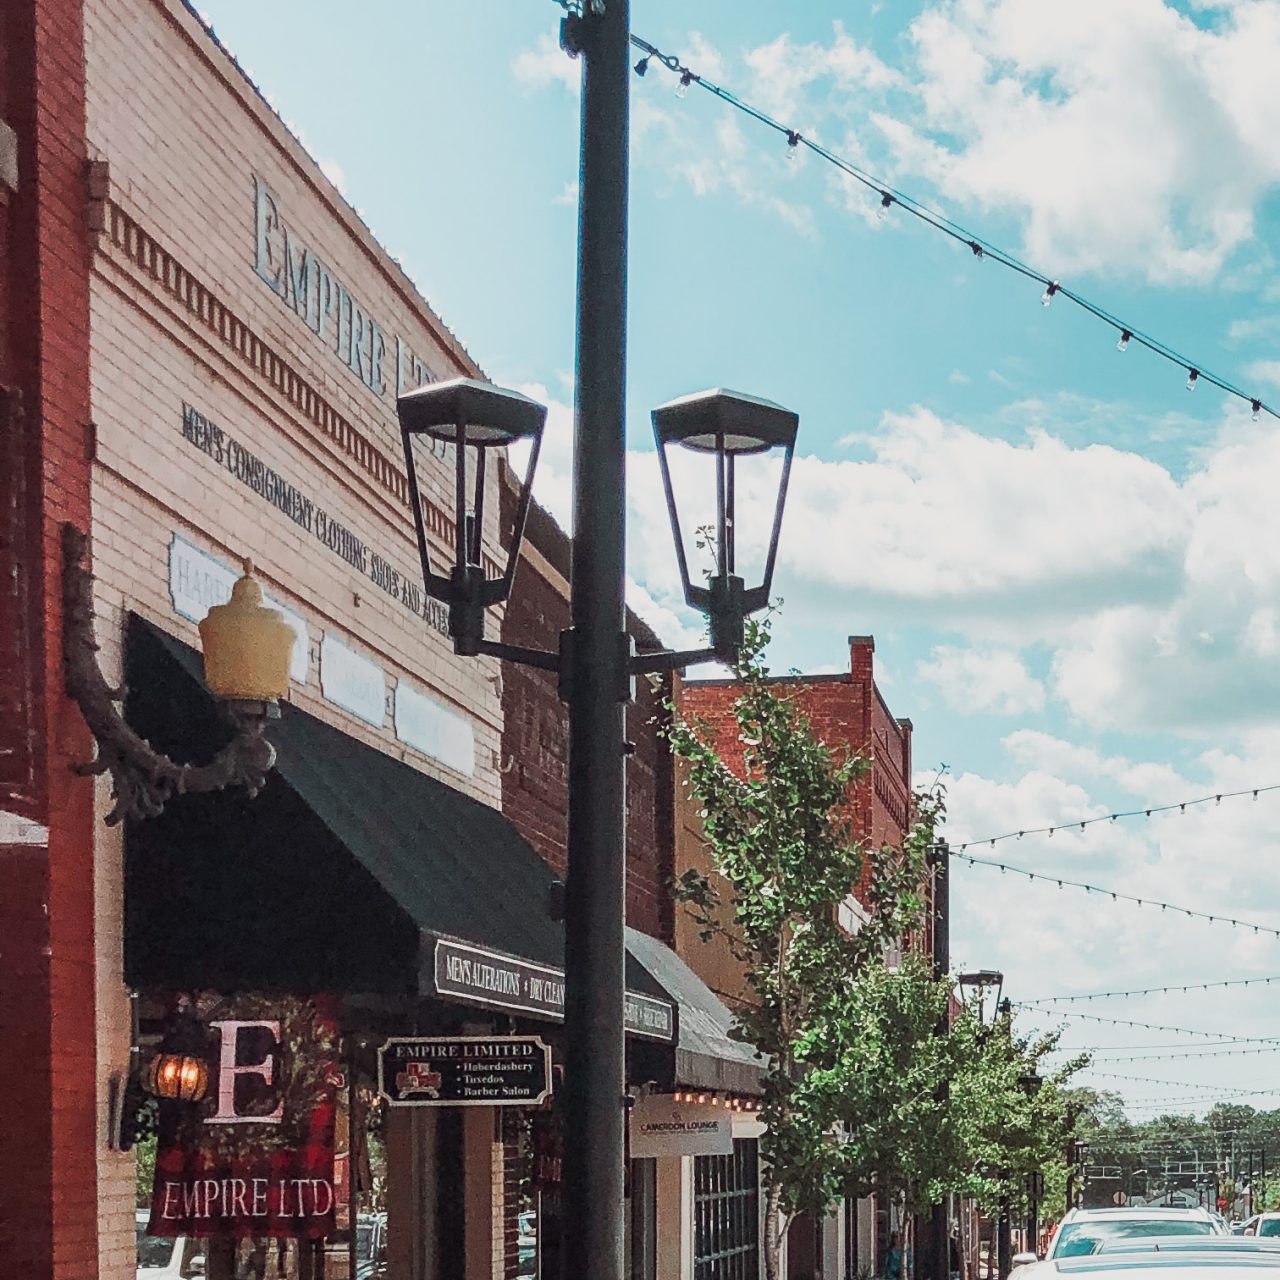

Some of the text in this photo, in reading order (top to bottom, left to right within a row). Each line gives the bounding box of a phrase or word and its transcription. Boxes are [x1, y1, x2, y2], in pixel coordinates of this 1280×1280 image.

[251, 173, 386, 402] EMPIRE
[182, 400, 224, 463] MEN'S
[227, 438, 314, 533] CONSIGNMENT
[316, 508, 367, 574] CLOTHING
[371, 552, 400, 599] SHOES
[401, 577, 420, 616] AND
[446, 955, 565, 1005] MEN'S ALTERATIONS DRY CLEAN
[396, 1045, 533, 1058] EMPIRE LIMITED
[204, 1020, 284, 1124] E
[463, 1063, 533, 1073] Haberdashery
[464, 1076, 504, 1084] Tuxedos
[464, 1086, 530, 1096] Barber Salon
[687, 1120, 718, 1130] LOUNGE
[161, 1179, 333, 1219] EMPIRE LTD
